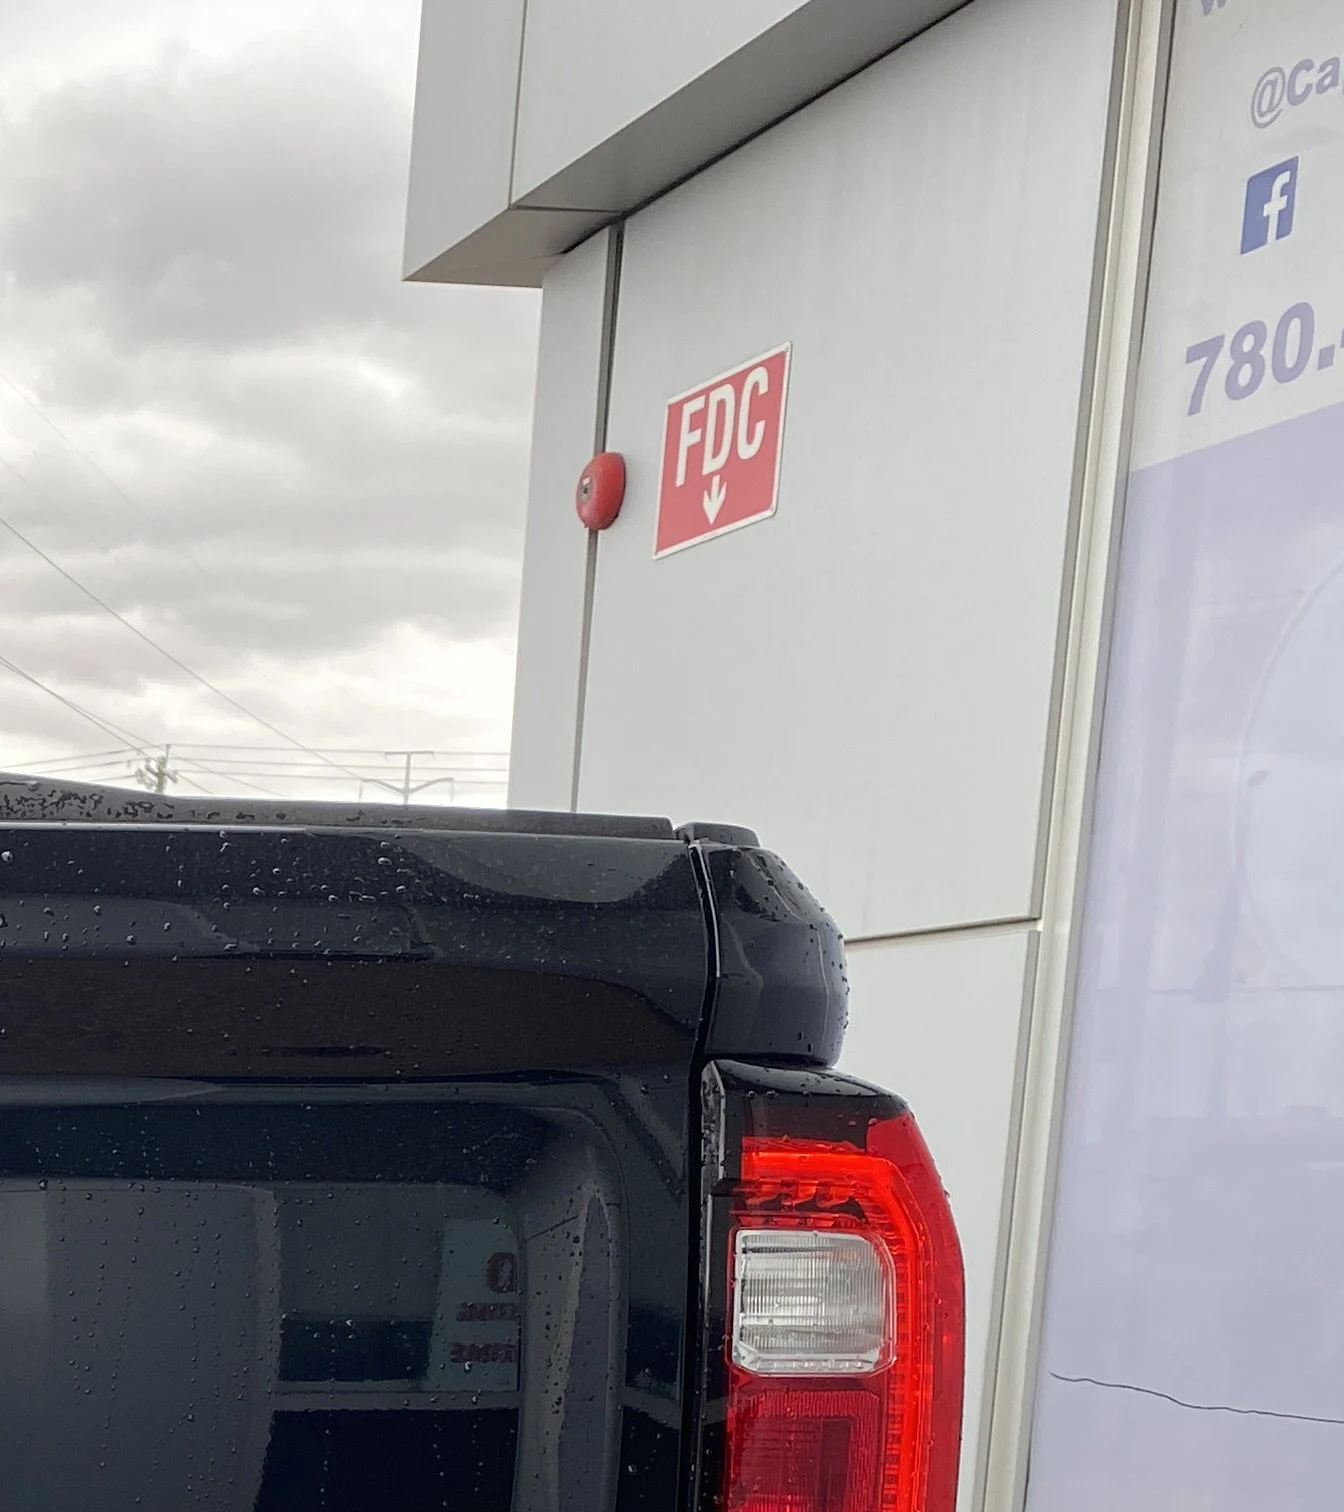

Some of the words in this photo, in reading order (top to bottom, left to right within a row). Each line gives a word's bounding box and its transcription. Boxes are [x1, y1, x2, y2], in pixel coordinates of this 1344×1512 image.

[1251, 56, 1344, 129] @Ca
[1184, 302, 1344, 417] 780.
[675, 366, 769, 488] FDC
